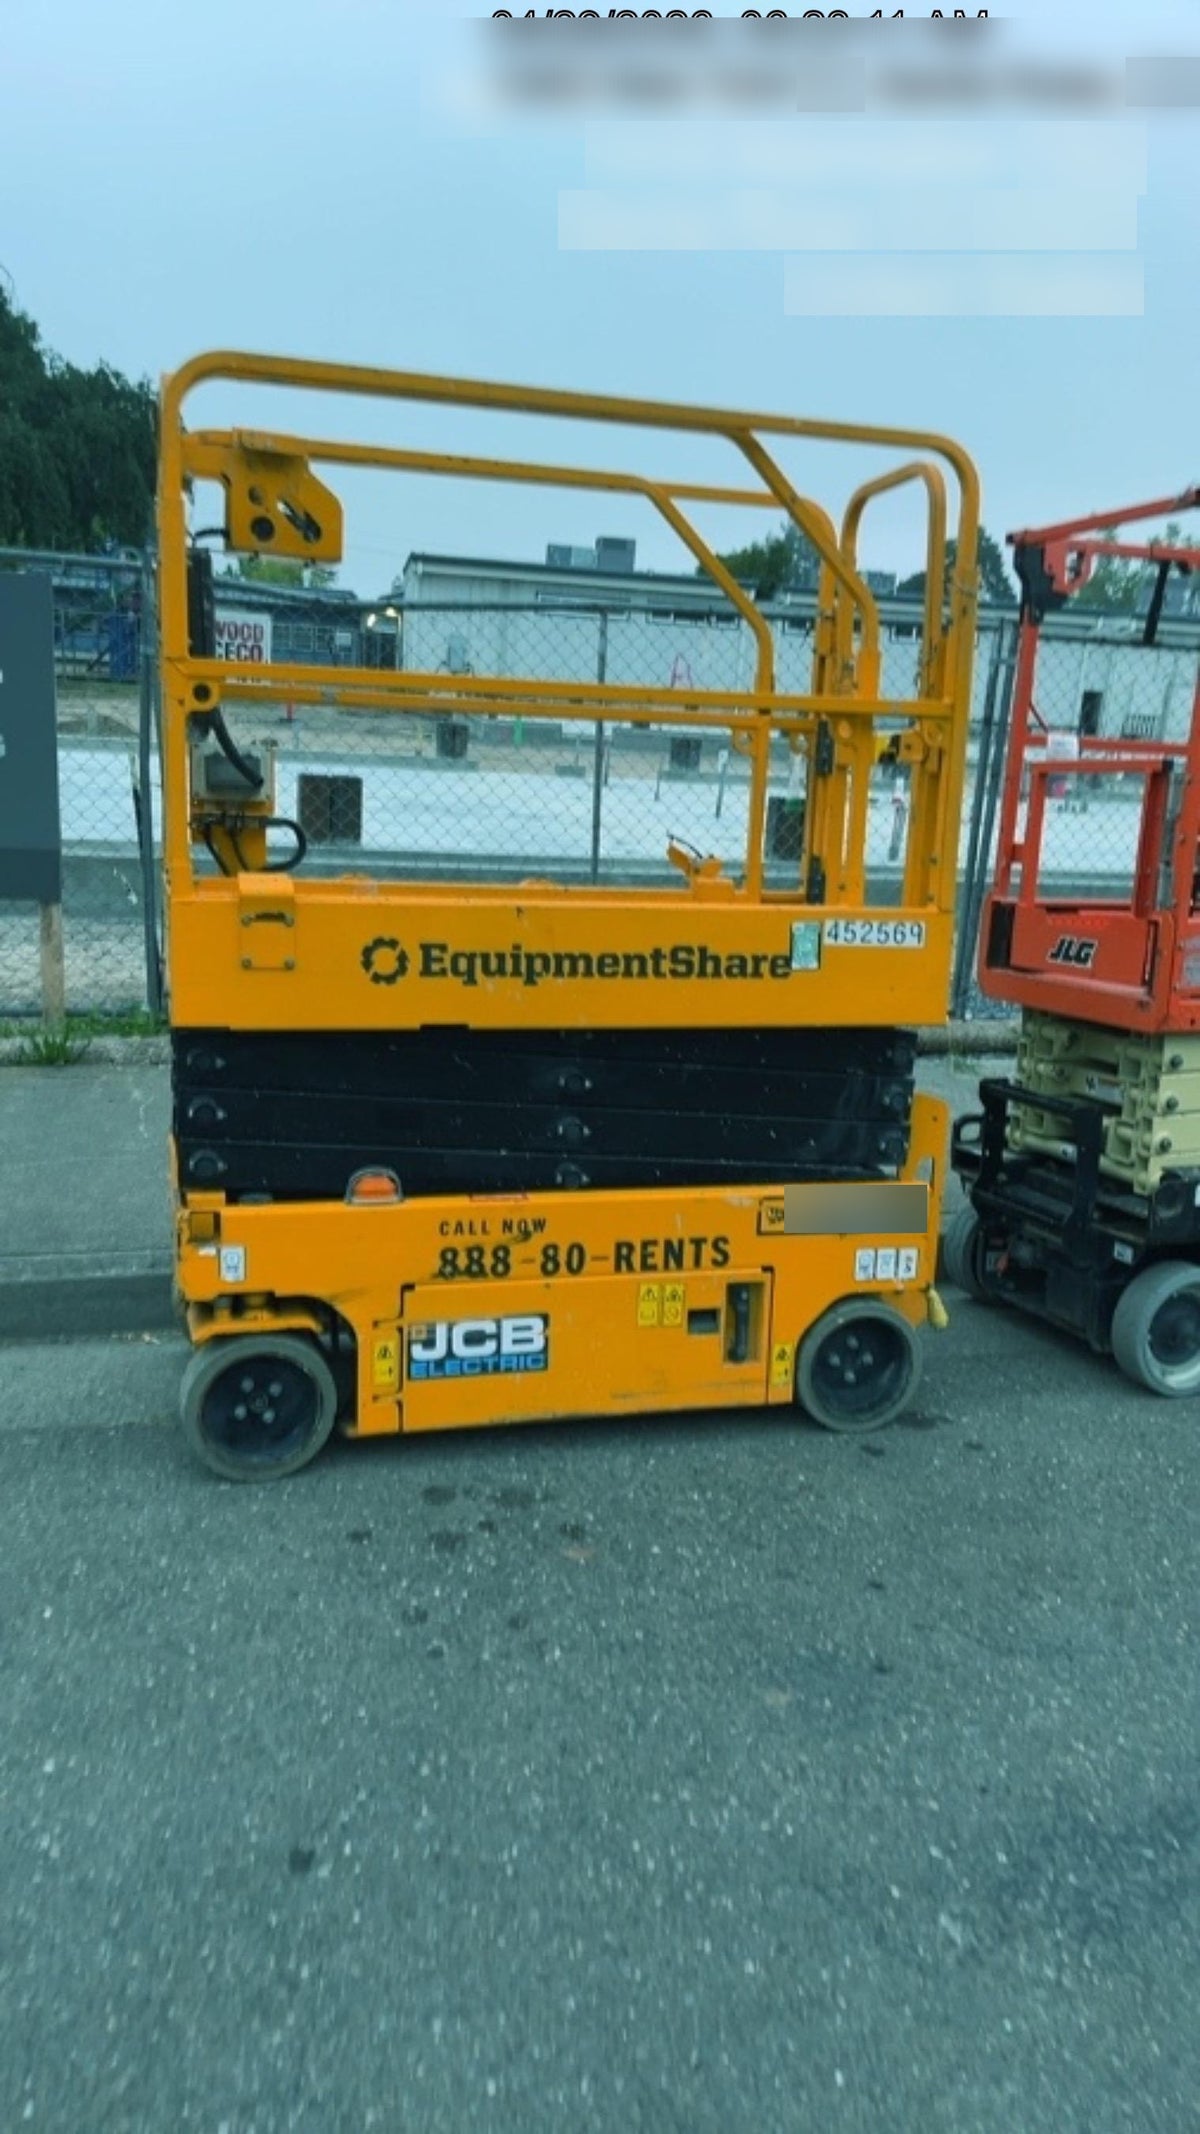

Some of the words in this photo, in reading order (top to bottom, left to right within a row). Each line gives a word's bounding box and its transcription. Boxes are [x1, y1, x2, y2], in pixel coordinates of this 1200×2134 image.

[827, 920, 923, 945] 452569
[419, 943, 791, 985] EquipmentShare
[1048, 935, 1097, 967] JLG
[439, 1219, 490, 1236] CALL
[502, 1217, 547, 1234] NOW
[411, 1317, 545, 1361] JCB
[411, 1354, 545, 1378] ELECTRIC
